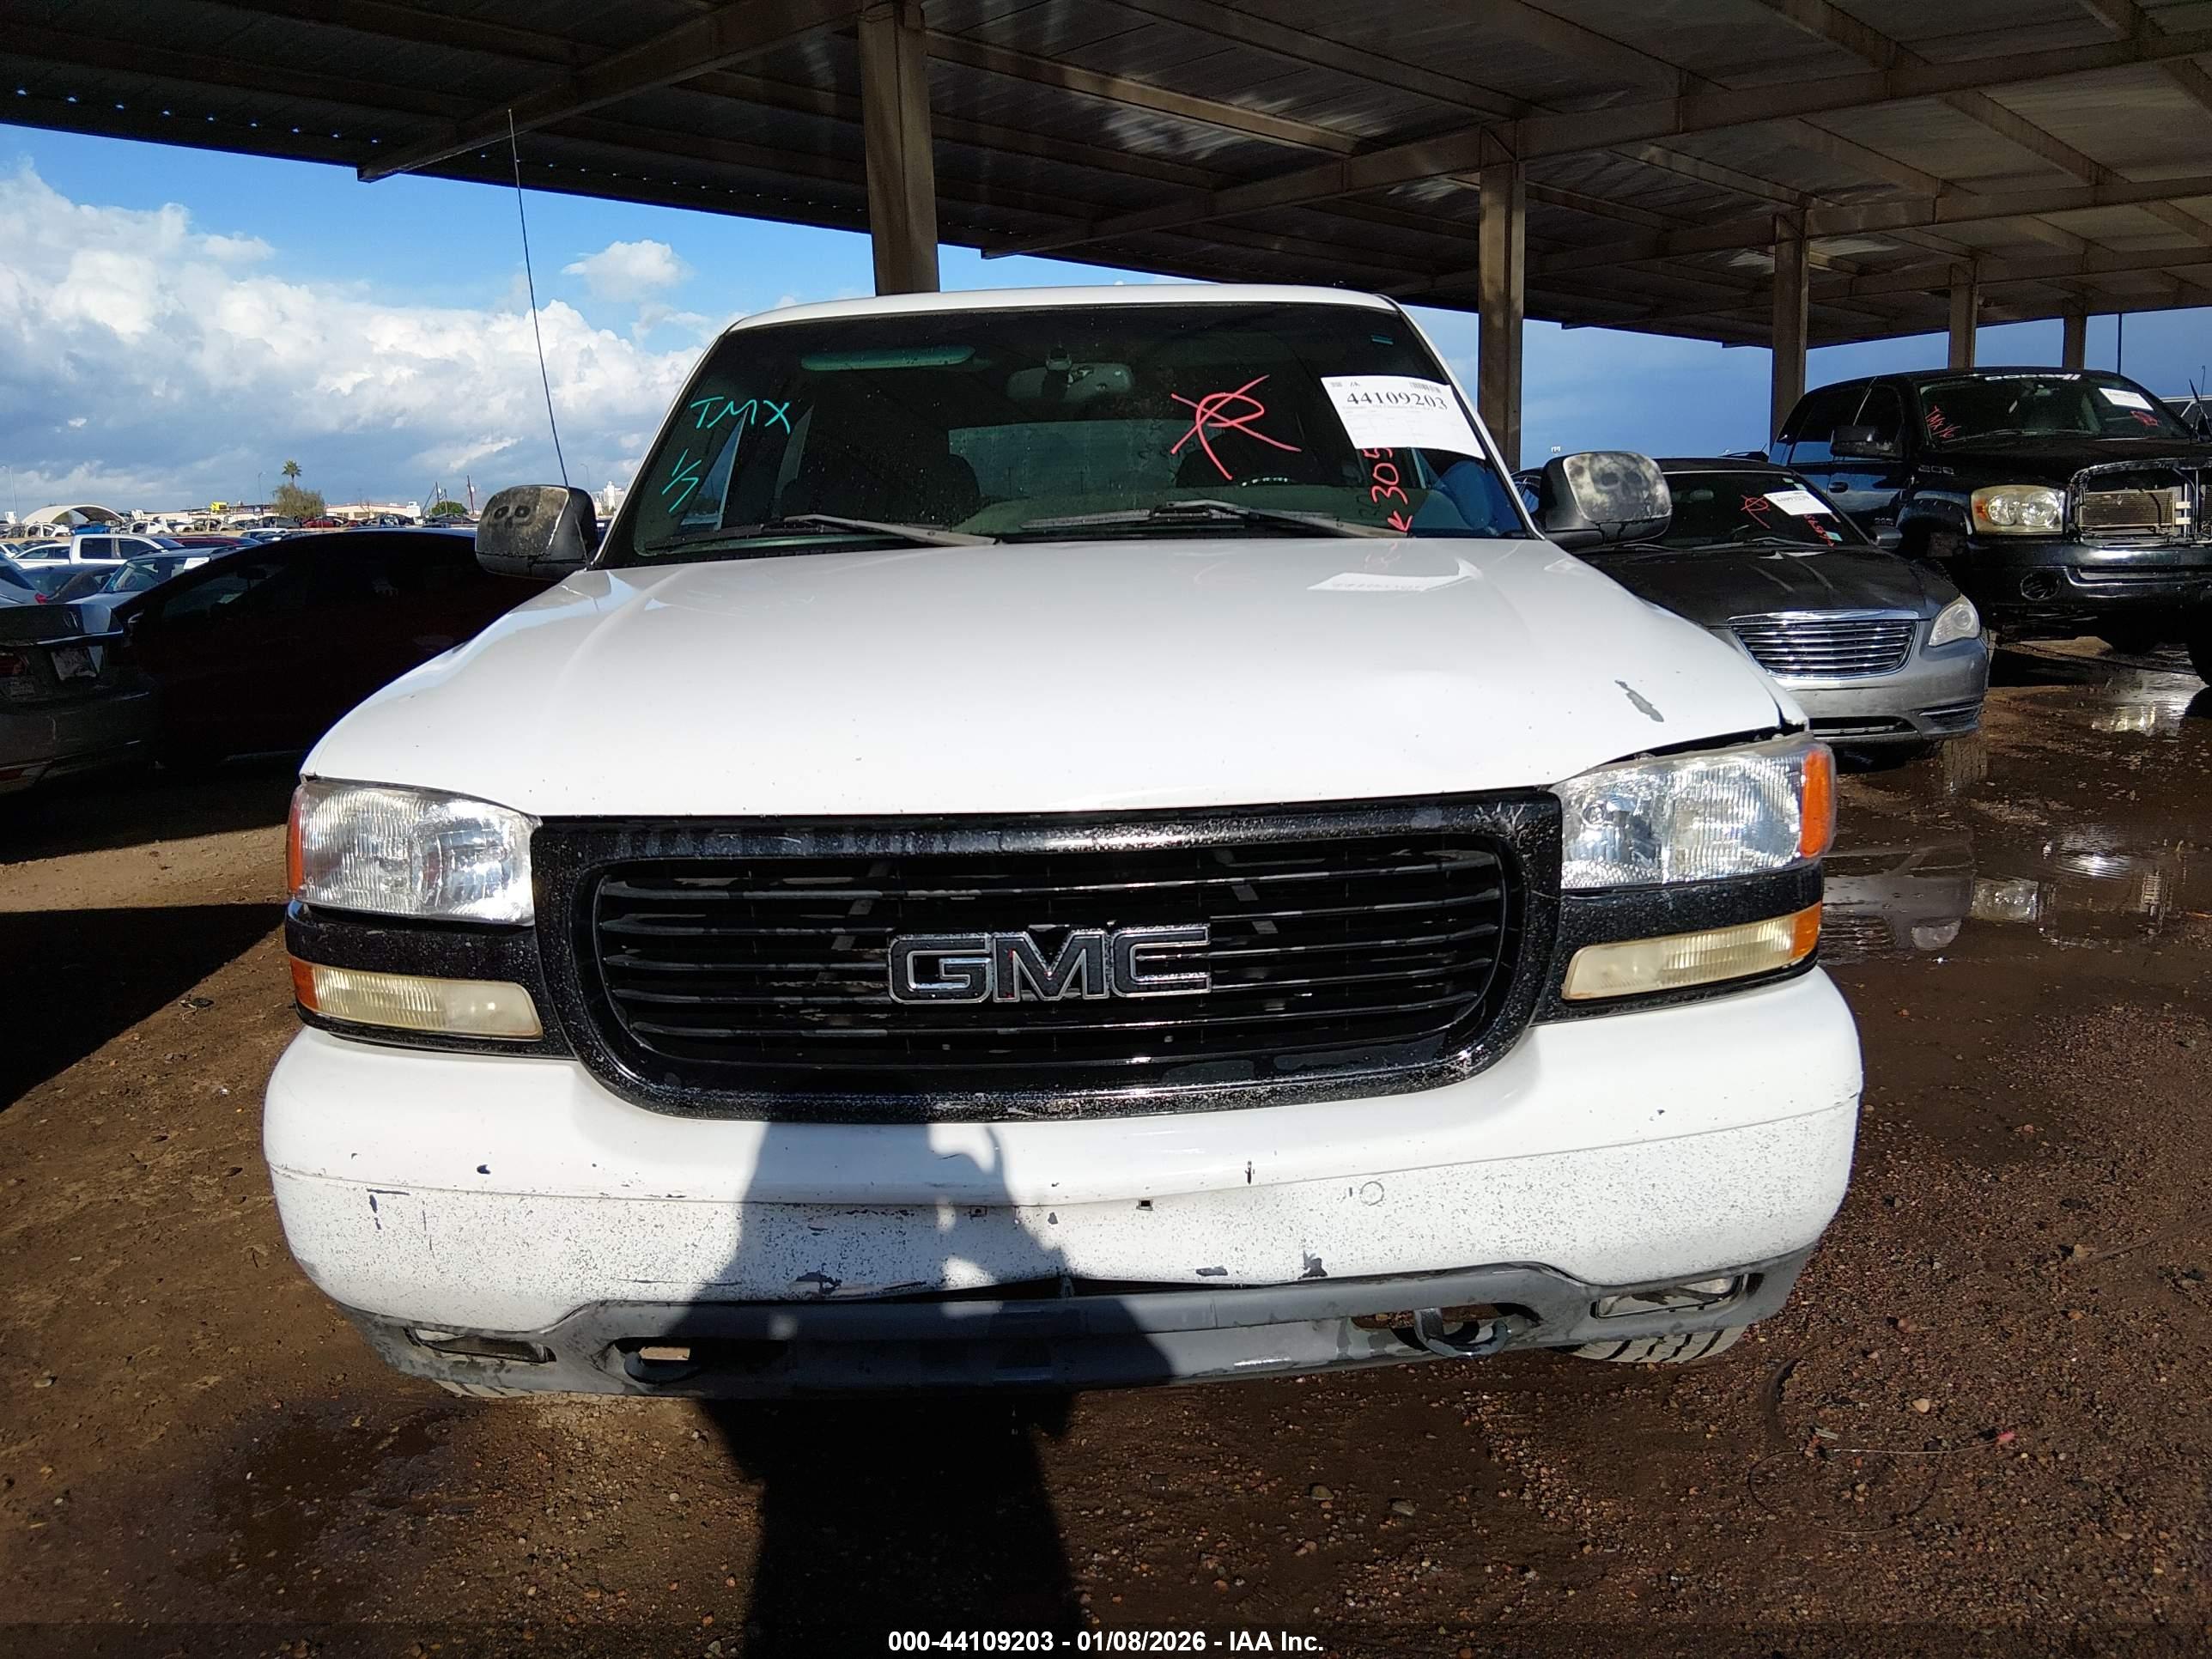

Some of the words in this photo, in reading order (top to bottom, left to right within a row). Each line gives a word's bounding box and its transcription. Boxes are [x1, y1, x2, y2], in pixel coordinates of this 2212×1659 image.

[690, 396, 791, 434] TMX
[1346, 392, 1448, 410] 44109203
[888, 923, 1212, 1005] GMC
